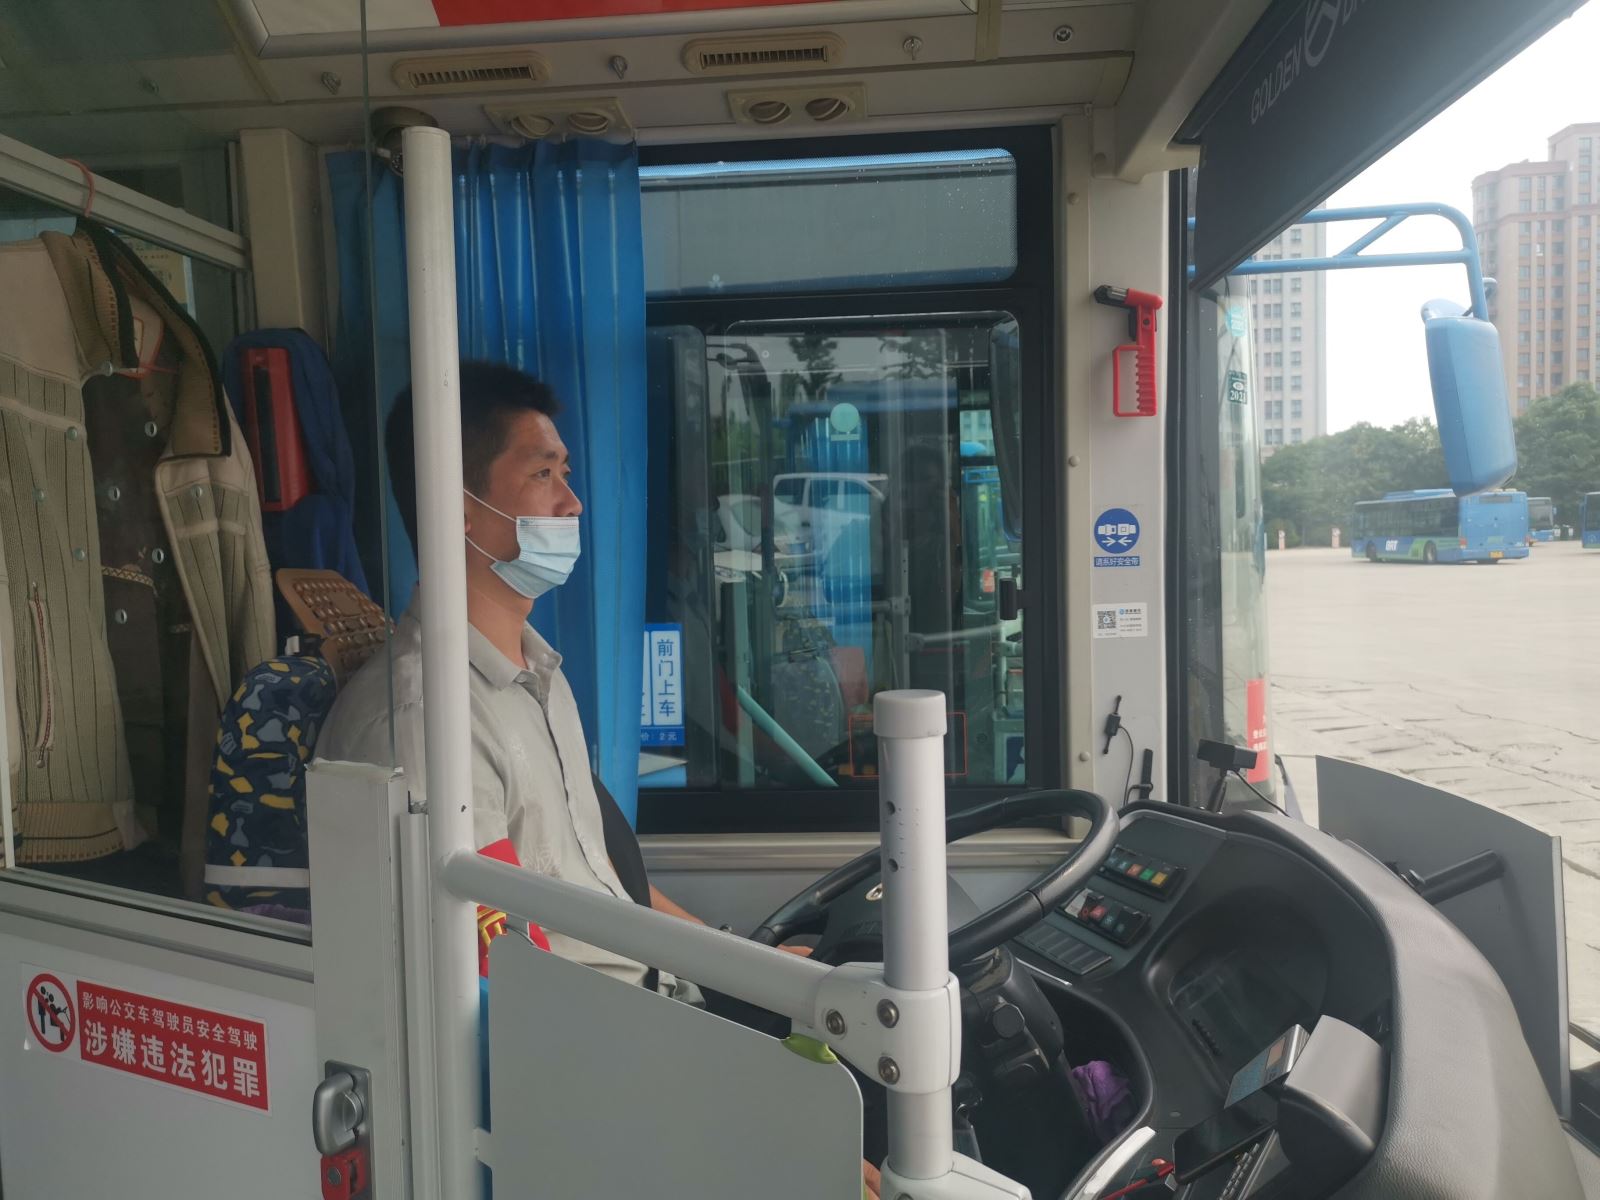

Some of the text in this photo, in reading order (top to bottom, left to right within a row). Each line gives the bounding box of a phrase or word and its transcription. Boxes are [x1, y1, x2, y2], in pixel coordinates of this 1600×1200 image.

[1251, 37, 1302, 125] GOLDEN
[657, 639, 675, 717] 前门上车
[82, 991, 258, 1051] 影响公交车驾驶员安全驾驶
[84, 1019, 260, 1097] 涉嫌违法犯罪
